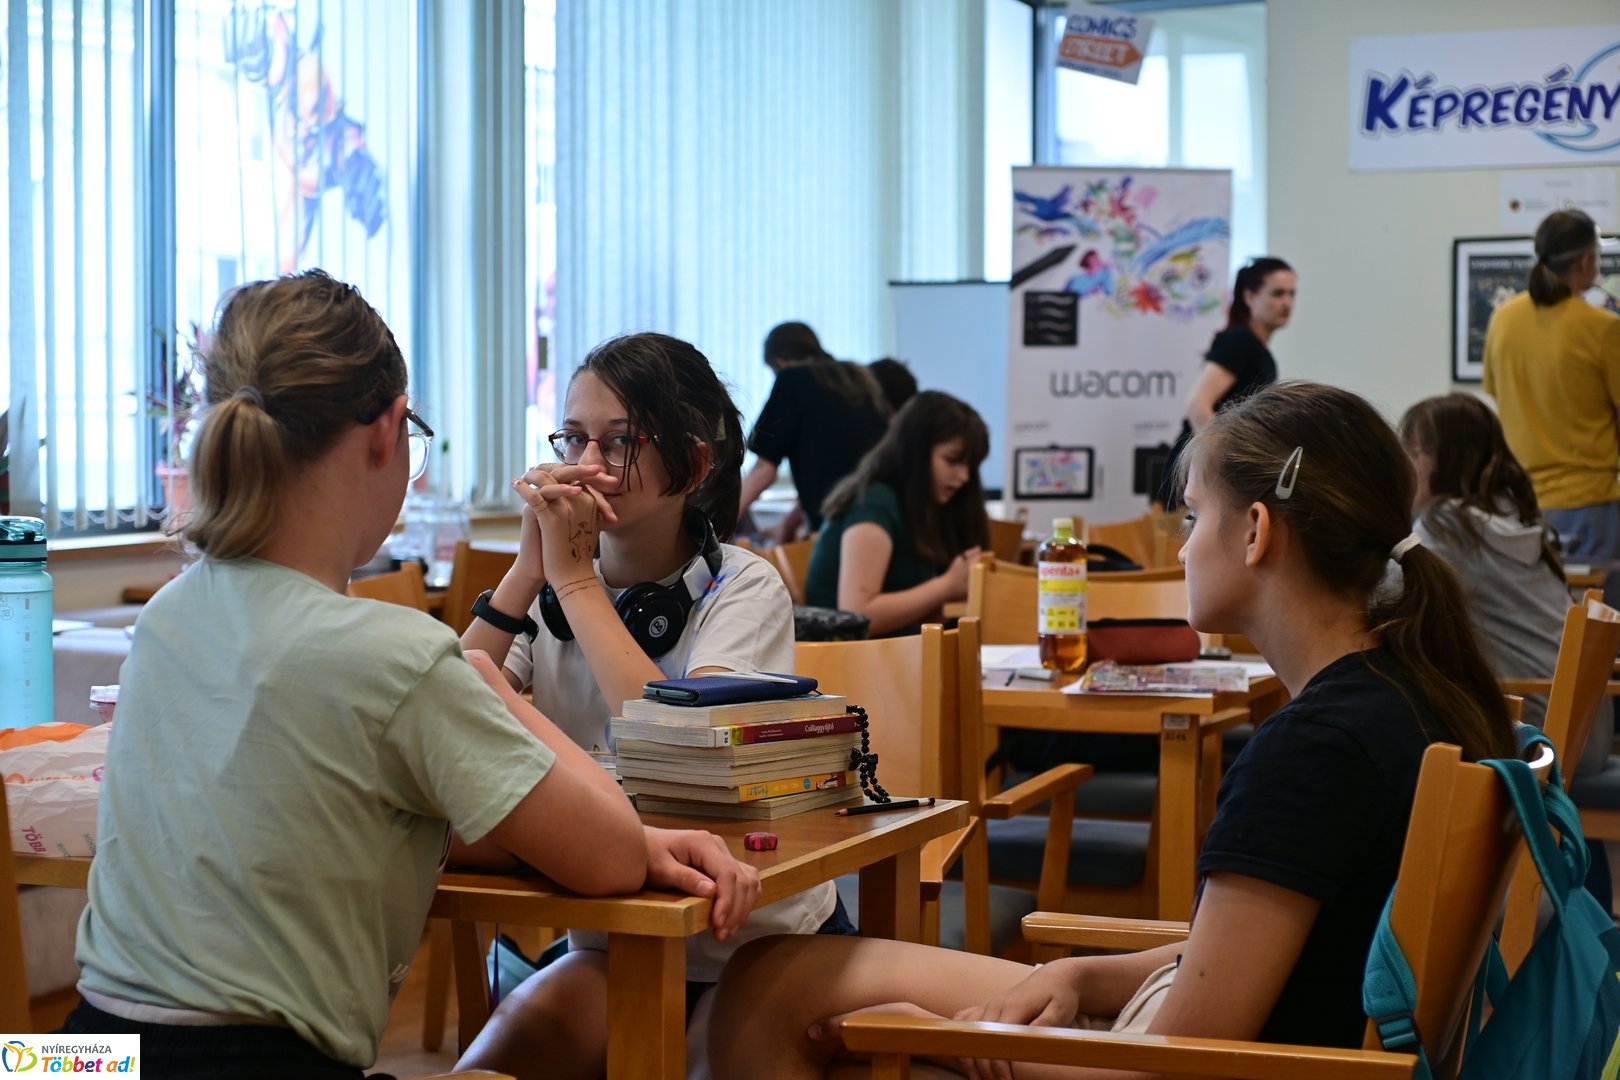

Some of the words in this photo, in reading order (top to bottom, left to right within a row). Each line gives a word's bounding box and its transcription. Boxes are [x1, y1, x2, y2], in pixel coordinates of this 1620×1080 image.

[1068, 14, 1138, 38] COMICS
[1363, 65, 1620, 132] KÉPREGÉNY
[1050, 370, 1176, 398] wacom
